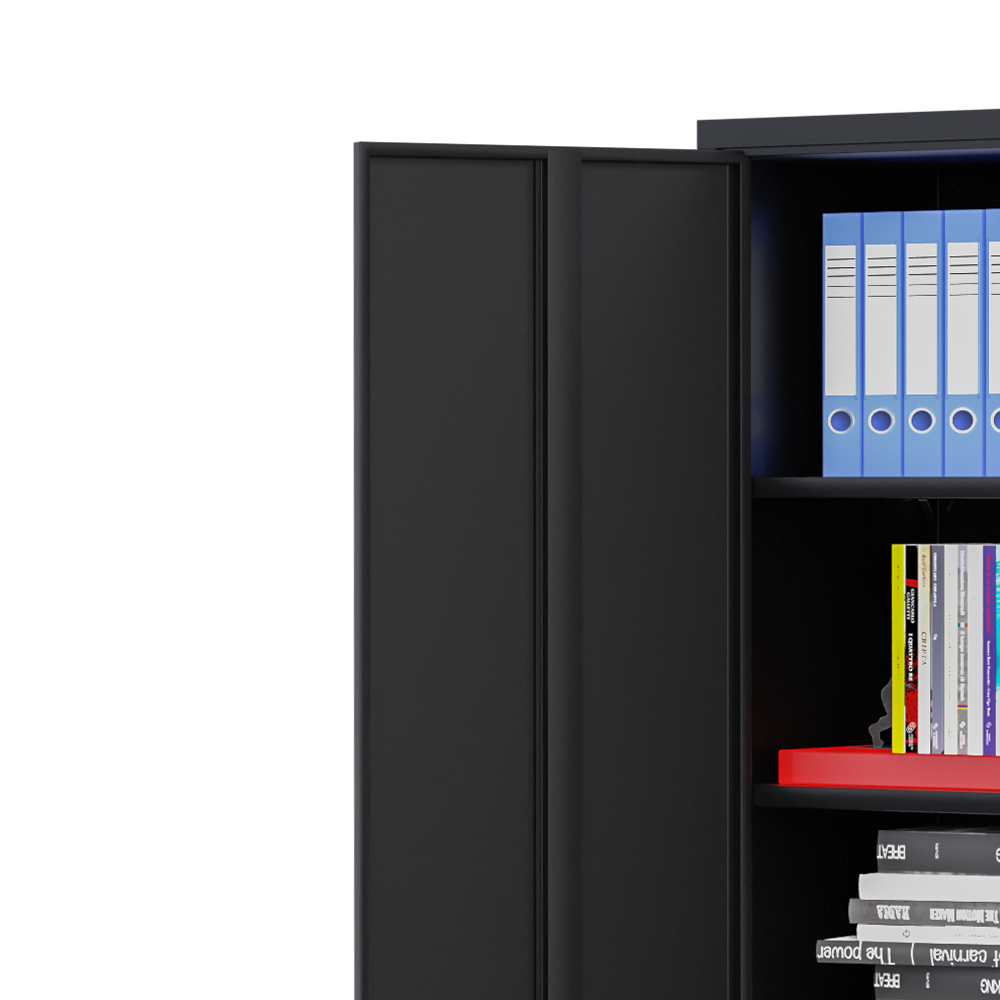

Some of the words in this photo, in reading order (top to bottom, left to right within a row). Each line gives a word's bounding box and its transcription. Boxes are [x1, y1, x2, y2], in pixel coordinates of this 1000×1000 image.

[876, 844, 906, 860] BREAT
[929, 908, 955, 922] MAKER
[955, 909, 985, 923] MOTION
[816, 941, 863, 960] power
[866, 947, 895, 966] The
[929, 948, 988, 968] carnival
[873, 972, 900, 989] BREAT
